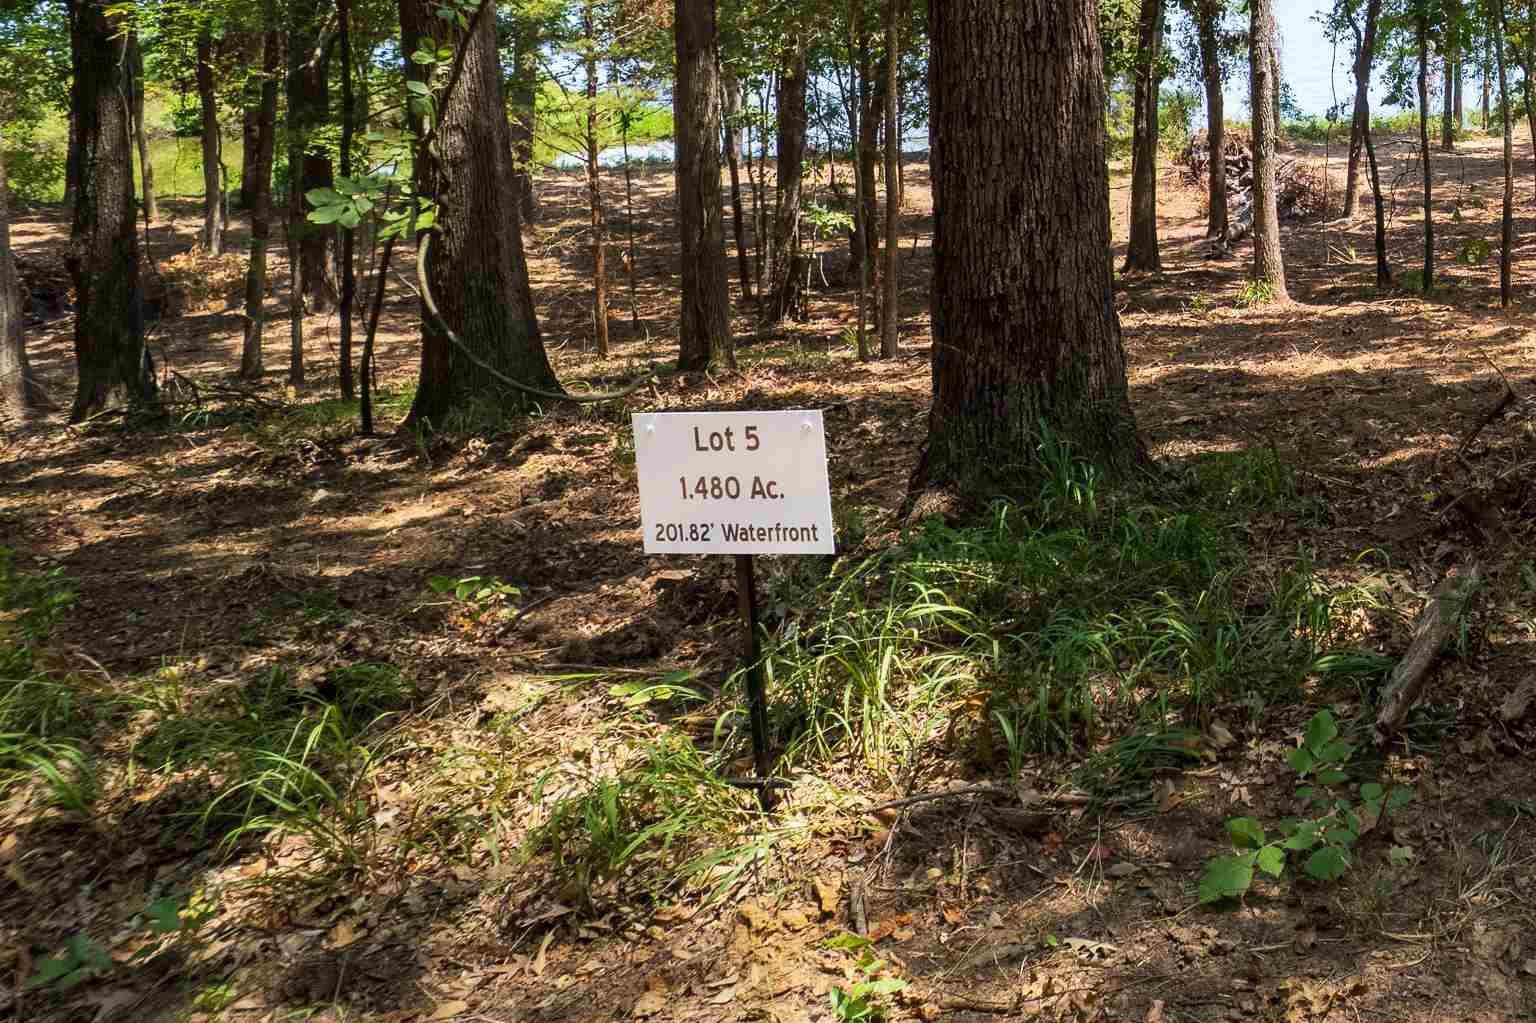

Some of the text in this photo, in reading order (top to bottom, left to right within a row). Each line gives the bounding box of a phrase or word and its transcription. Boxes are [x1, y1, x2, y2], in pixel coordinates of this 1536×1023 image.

[692, 425, 760, 452] Lot 5
[679, 475, 785, 500] 1.480 Ac.
[655, 522, 819, 542] 201.82' Waterfront
